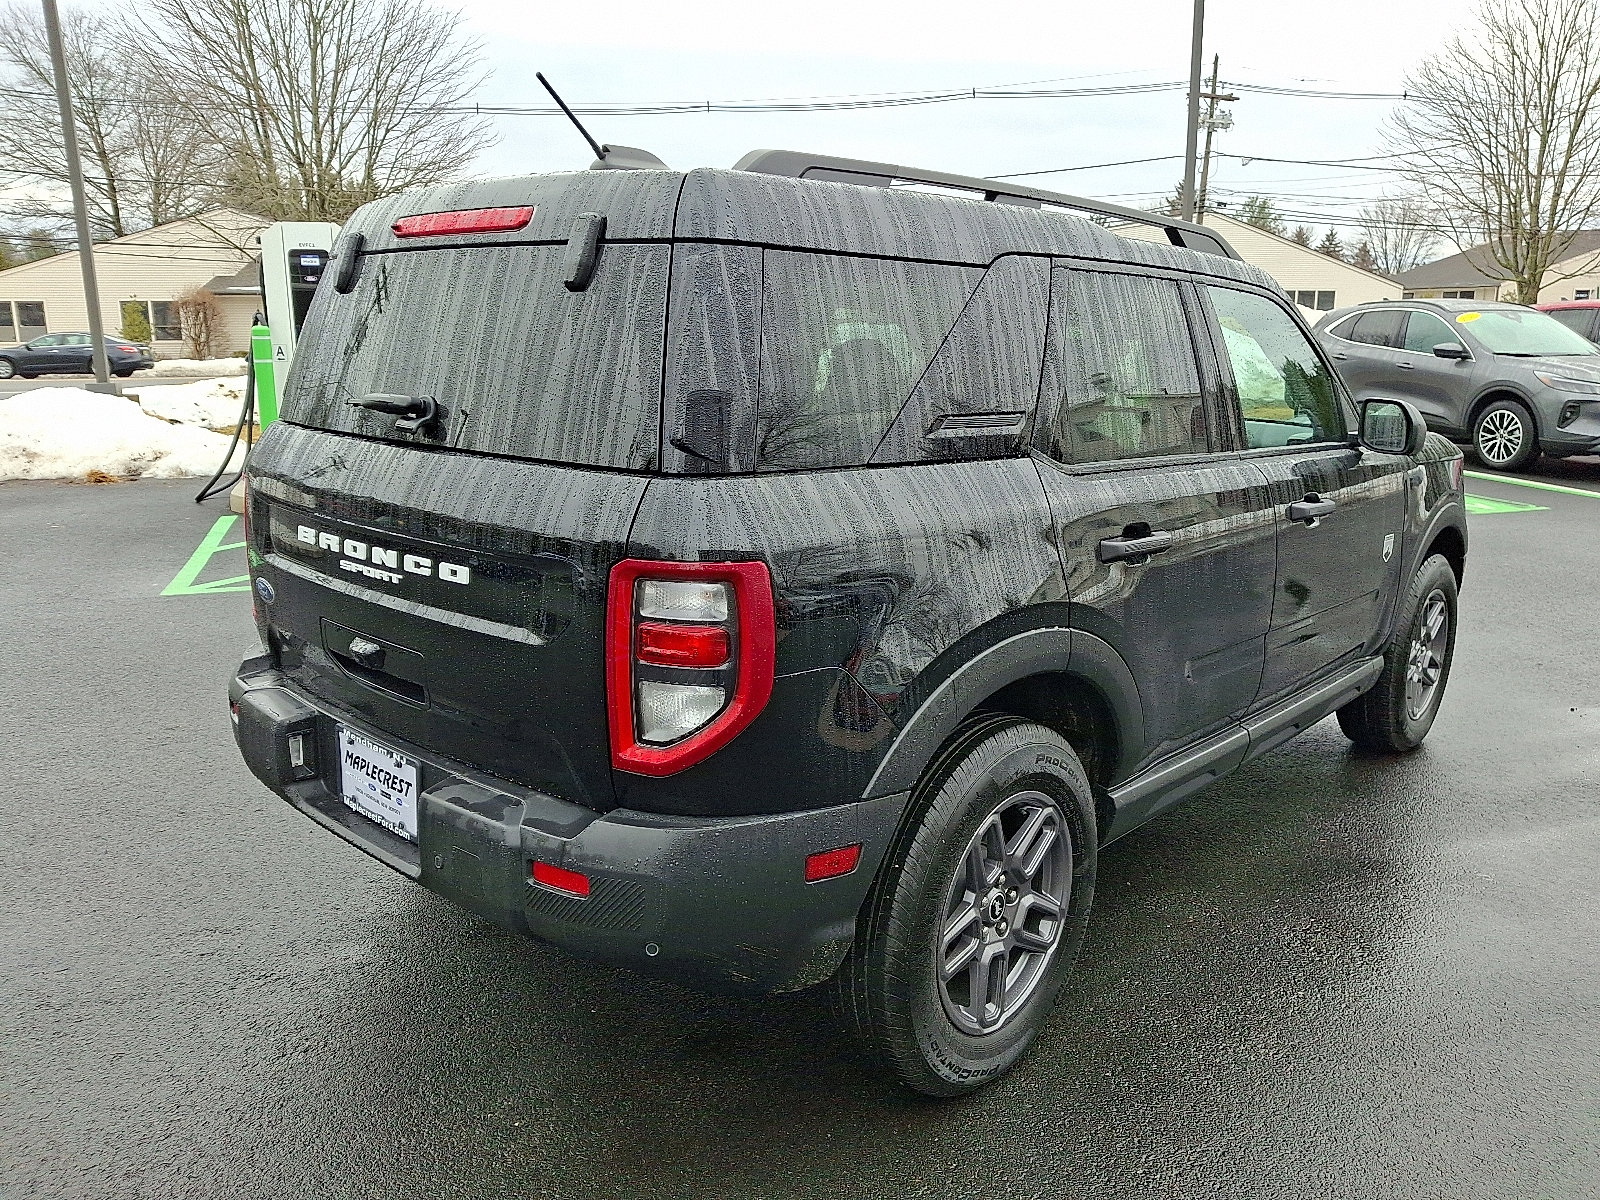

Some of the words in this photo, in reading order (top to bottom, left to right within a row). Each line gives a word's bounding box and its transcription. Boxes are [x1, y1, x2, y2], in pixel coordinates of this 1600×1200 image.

[276, 346, 284, 356] A
[297, 525, 471, 585] BRONCO
[339, 559, 403, 584] SPORT
[344, 749, 413, 798] MAPLECREST
[343, 795, 411, 841] MaplecrestFord.com
